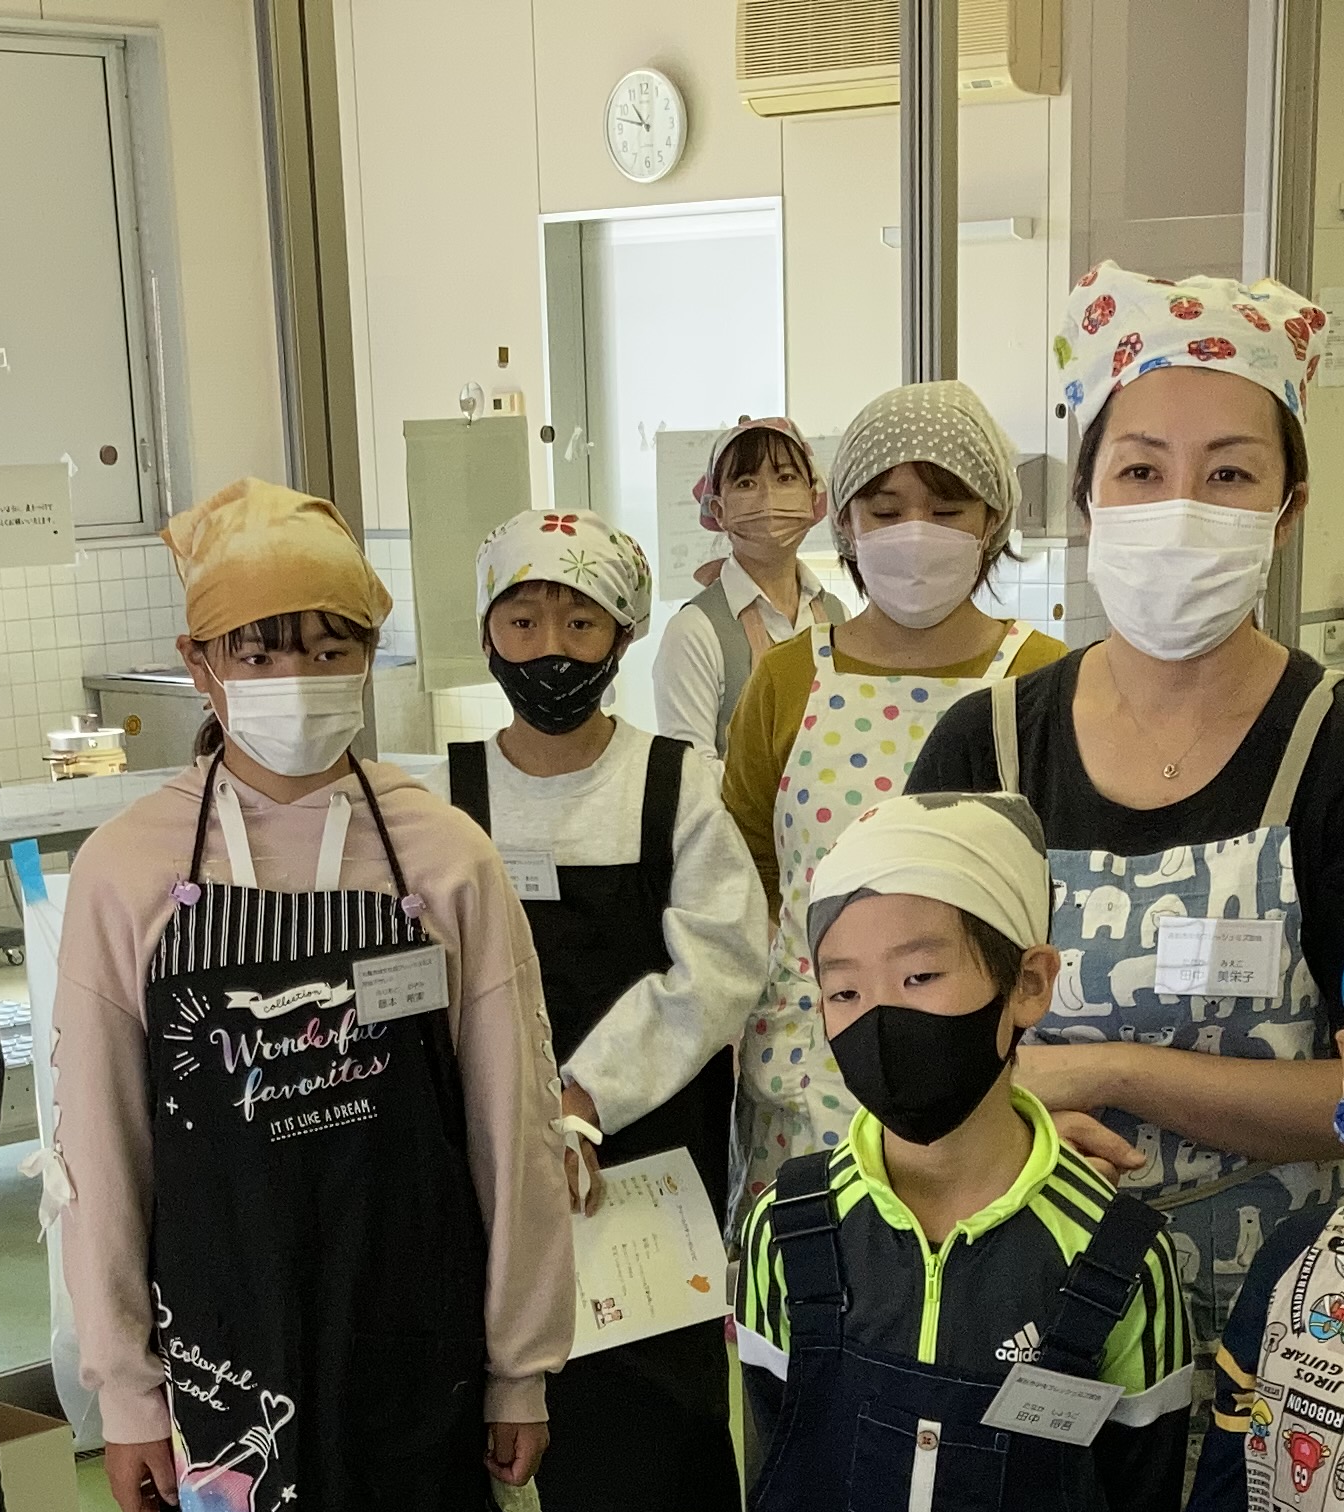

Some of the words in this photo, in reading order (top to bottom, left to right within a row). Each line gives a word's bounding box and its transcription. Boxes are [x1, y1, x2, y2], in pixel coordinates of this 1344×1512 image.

[263, 989, 322, 1013] collection
[210, 1008, 387, 1074] Wonderful
[233, 1053, 391, 1122] favorites
[270, 1120, 282, 1135] IT
[285, 1117, 295, 1132] IS
[297, 1111, 322, 1128] LIKE
[170, 1340, 253, 1390] Colorful
[995, 1347, 1043, 1362] adida
[1280, 1347, 1344, 1376] GUITAR
[174, 1379, 226, 1412] soda
[1286, 1392, 1344, 1429] ROBOCON
[1015, 1410, 1041, 1425] 田中
